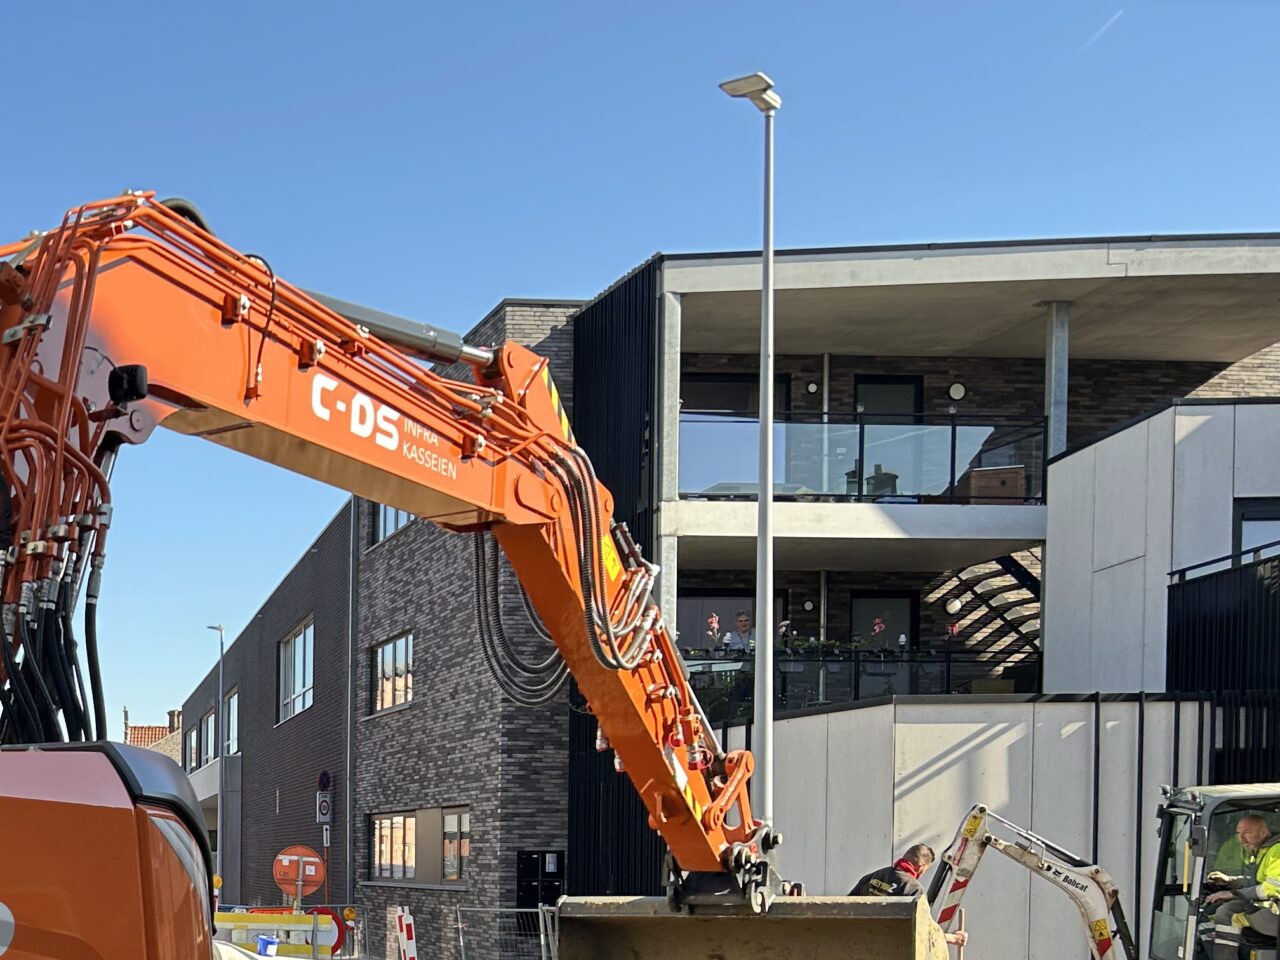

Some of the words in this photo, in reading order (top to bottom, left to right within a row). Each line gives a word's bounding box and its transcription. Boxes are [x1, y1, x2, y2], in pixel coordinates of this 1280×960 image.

[312, 373, 401, 451] C-DS
[404, 418, 439, 446] INFRA
[403, 440, 457, 481] KASSEIEN
[1062, 875, 1089, 892] Bobcat
